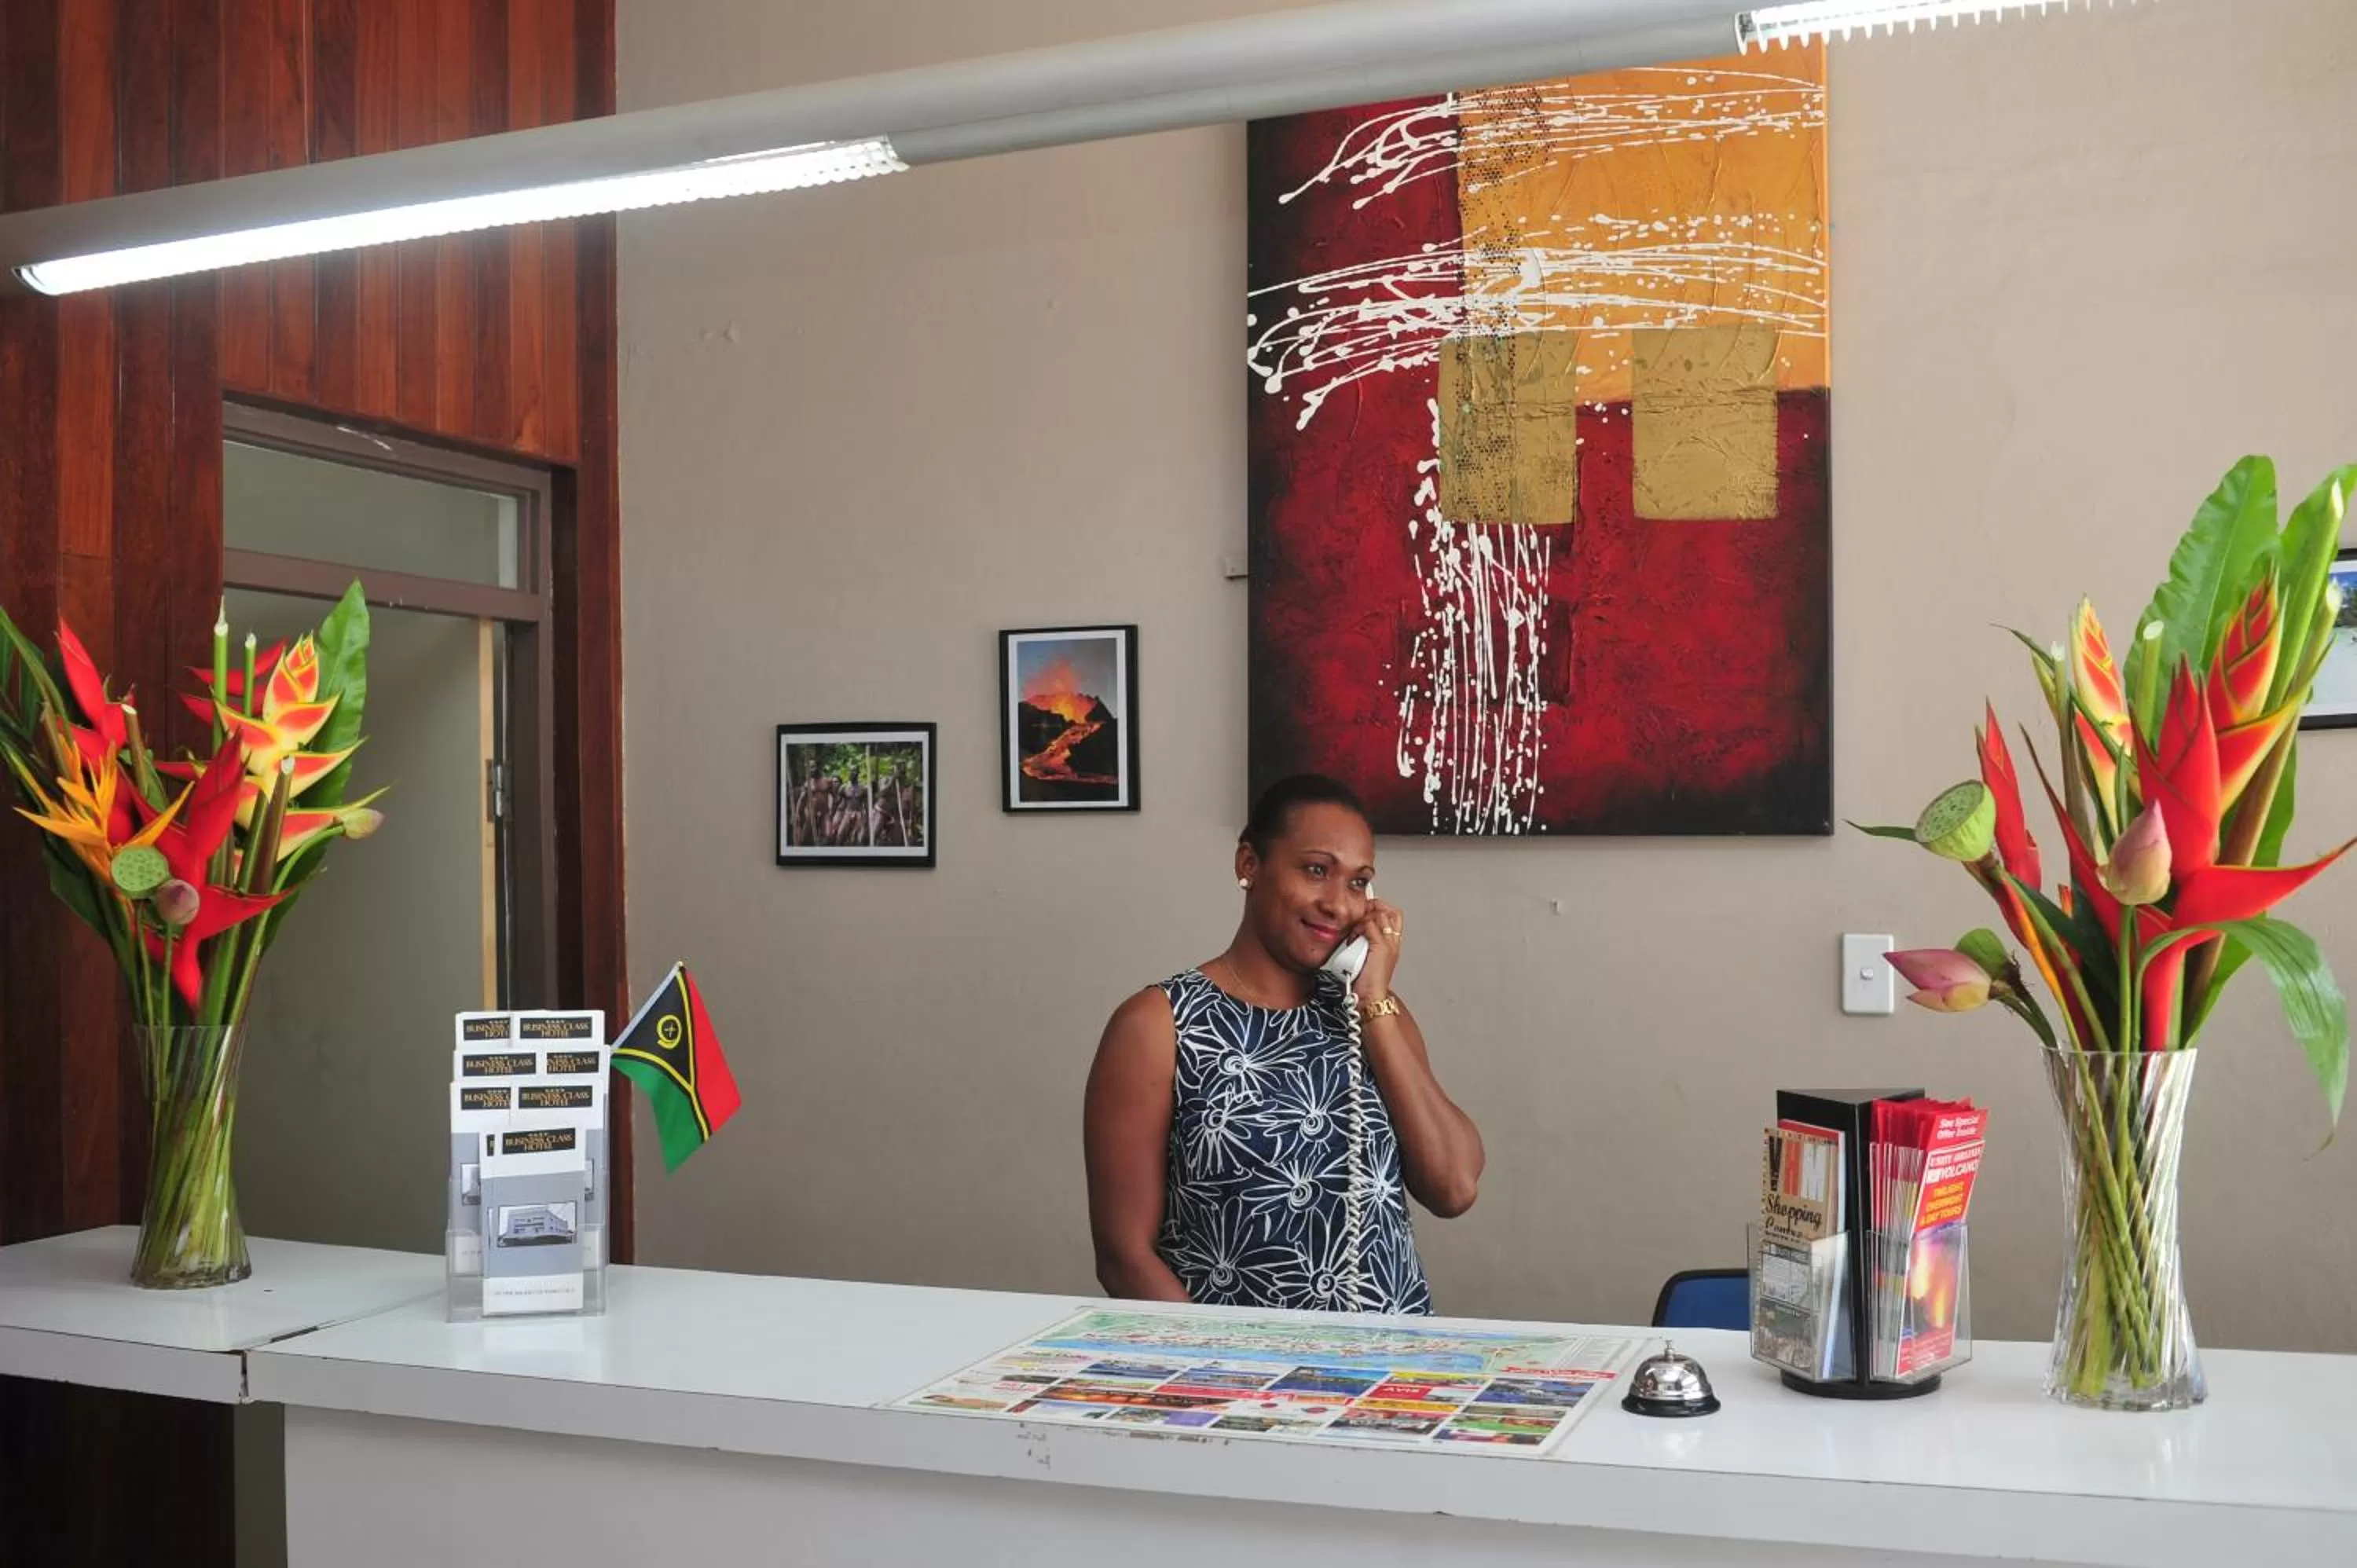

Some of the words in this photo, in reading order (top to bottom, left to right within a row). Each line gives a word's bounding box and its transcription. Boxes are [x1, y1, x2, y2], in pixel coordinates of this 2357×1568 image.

[466, 1024, 506, 1032] BUSINESS
[466, 1059, 506, 1068] BUSINESS
[507, 1057, 533, 1067] CLASS
[571, 1057, 596, 1066] CLASS
[485, 1066, 514, 1075] HOTEL
[464, 1094, 504, 1102] BUSINESS
[522, 1093, 562, 1101] BUSINESS
[563, 1091, 588, 1100] CLASS
[505, 1136, 544, 1147] BUSINESS
[546, 1134, 573, 1143] CLASS
[523, 1142, 552, 1152] HOTEL
[1767, 1192, 1822, 1232] Shopping
